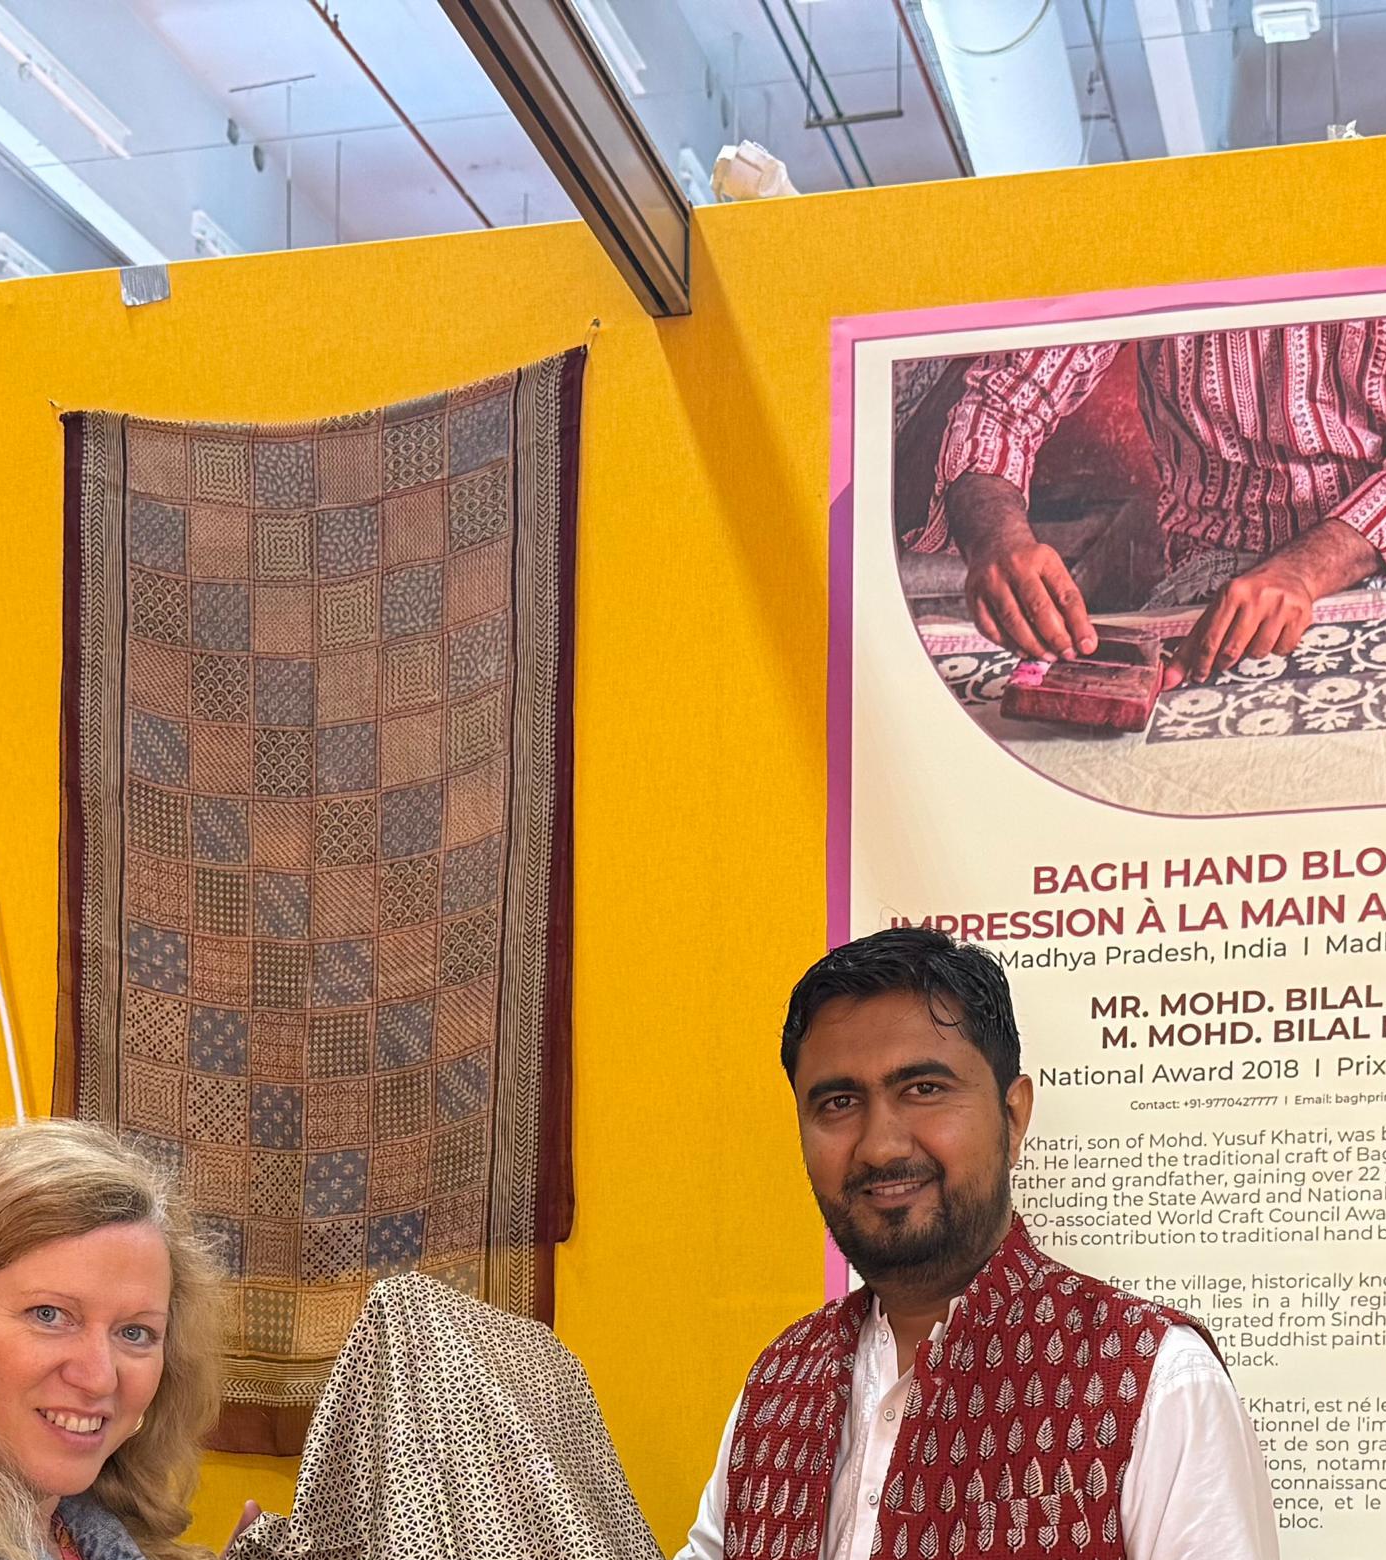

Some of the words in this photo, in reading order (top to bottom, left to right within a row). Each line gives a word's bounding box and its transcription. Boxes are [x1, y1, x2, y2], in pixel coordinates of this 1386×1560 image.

[1033, 861, 1147, 894] BAGH
[1164, 853, 1287, 887] HAND
[1135, 901, 1166, 934] À
[1178, 901, 1228, 931] LA
[1241, 894, 1344, 928] MAIN
[999, 947, 1097, 973] Madhya
[1106, 941, 1214, 964] Pradesh,
[1224, 937, 1286, 959] India
[1091, 995, 1148, 1019] MR.
[1160, 990, 1274, 1016] MOHD.
[1285, 984, 1383, 1011] BILAL
[1102, 1025, 1136, 1048] M.
[1148, 1021, 1261, 1047] MOHD.
[1273, 1016, 1370, 1042] BILAL
[1039, 1064, 1143, 1086] National
[1151, 1060, 1232, 1082] Award
[1241, 1059, 1298, 1079] 2018
[1337, 1054, 1386, 1076] Prix
[1130, 1100, 1179, 1110] Contact:
[1183, 1095, 1277, 1108] +91-9770427777
[1294, 1093, 1331, 1105] Email:
[1022, 1134, 1082, 1152] Khatri,
[1087, 1137, 1119, 1149] son
[1125, 1132, 1144, 1148] of
[1149, 1131, 1206, 1148] Mohd.
[1212, 1129, 1265, 1146] Yusuf
[1271, 1127, 1332, 1145] Khatri,
[1337, 1129, 1375, 1142] was
[1012, 1174, 1066, 1189] father
[1071, 1172, 1105, 1188] and
[1111, 1170, 1227, 1191] grandfather,
[1233, 1168, 1305, 1188] gaining
[1311, 1169, 1353, 1182] over
[1358, 1165, 1380, 1181] 22
[1022, 1192, 1107, 1210] including
[1112, 1191, 1143, 1207] the
[1148, 1191, 1196, 1206] State
[1200, 1188, 1260, 1205] Award
[1265, 1187, 1301, 1203] and
[1308, 1185, 1386, 1202] National
[1145, 1275, 1176, 1290] the
[1181, 1274, 1245, 1293] village,
[1251, 1272, 1353, 1291] historically
[1212, 1293, 1242, 1308] lies
[1252, 1292, 1269, 1308] in
[1279, 1296, 1289, 1308] a
[1301, 1291, 1340, 1310] hilly
[1249, 1397, 1309, 1414] Khatri,
[1314, 1399, 1342, 1412] est
[1347, 1397, 1371, 1412] né
